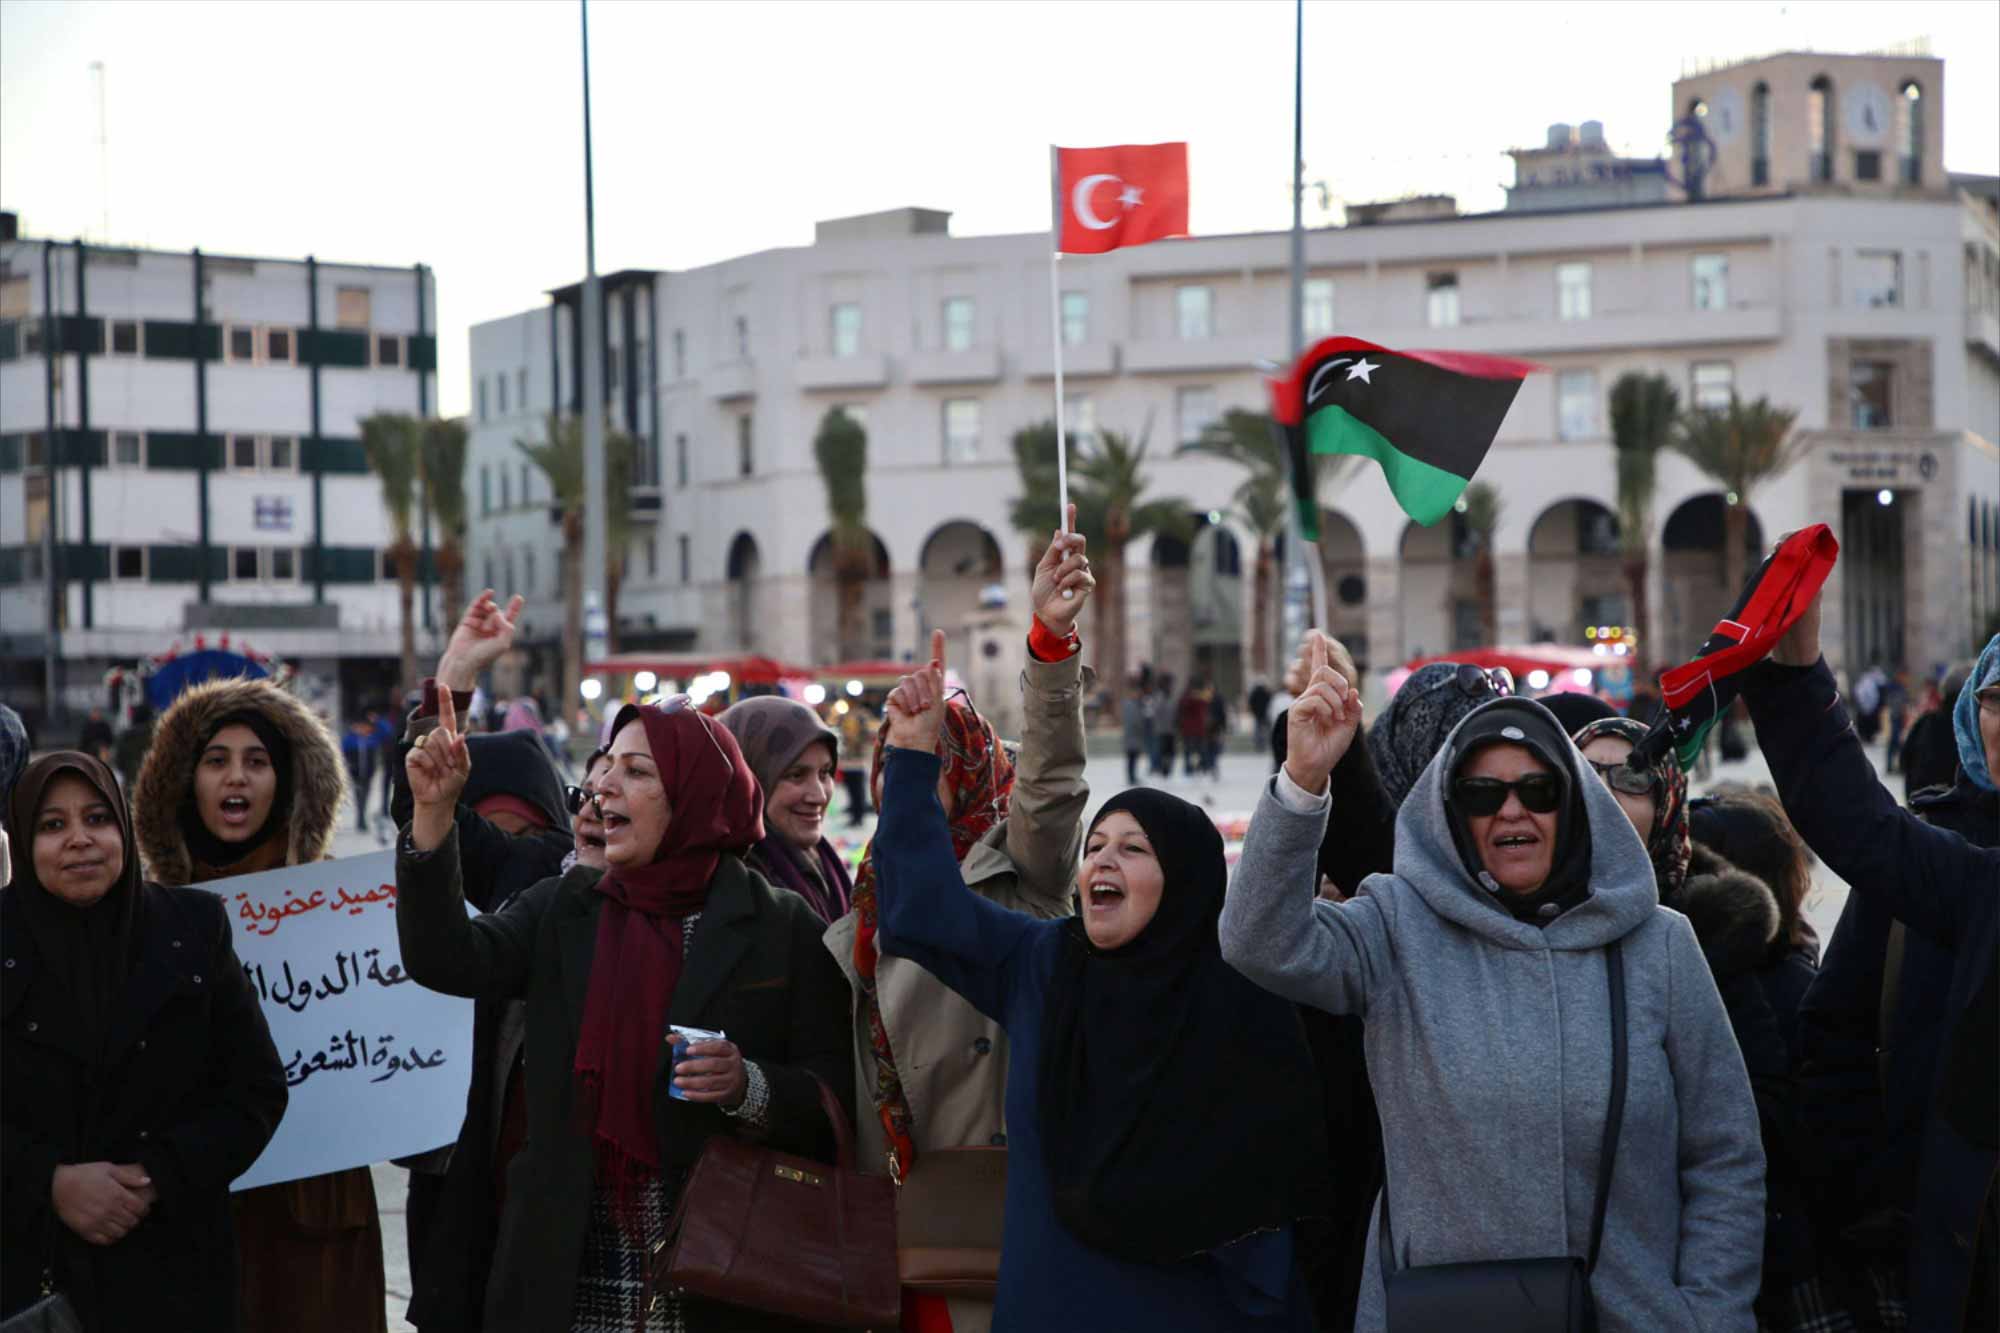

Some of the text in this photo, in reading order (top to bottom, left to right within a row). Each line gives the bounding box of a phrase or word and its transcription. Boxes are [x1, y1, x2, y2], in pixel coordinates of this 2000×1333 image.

[235, 884, 397, 936] جميد عضوية
[272, 951, 359, 1012] الدول
[370, 1035, 447, 1083] عدوة
